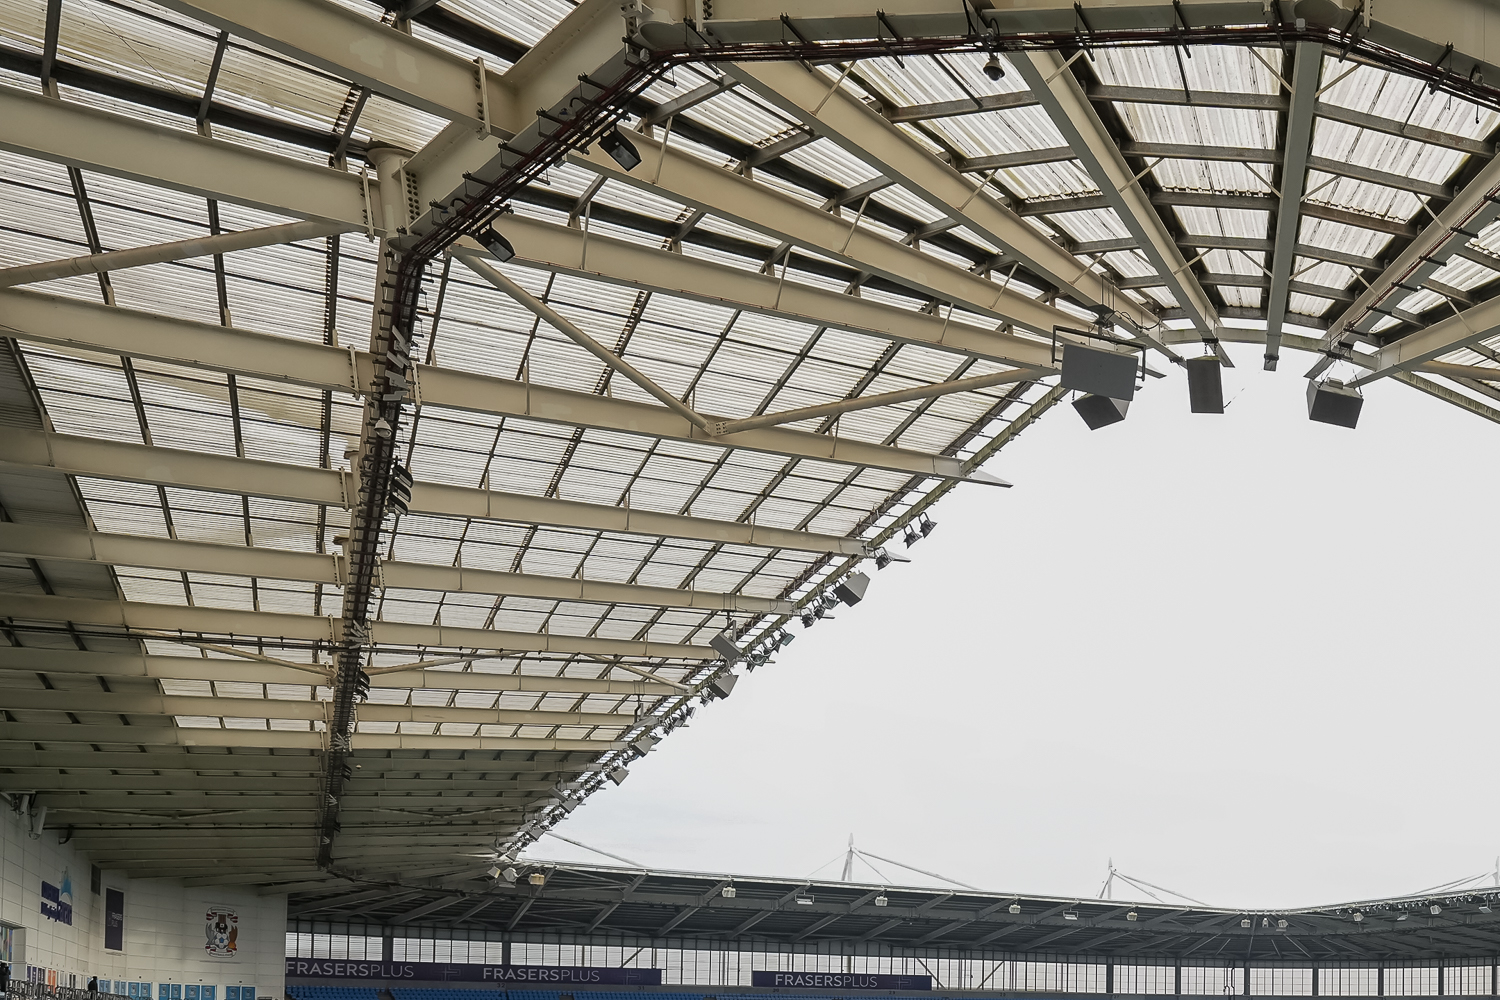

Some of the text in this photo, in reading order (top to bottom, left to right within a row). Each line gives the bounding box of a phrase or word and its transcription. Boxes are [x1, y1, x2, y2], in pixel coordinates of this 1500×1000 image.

[285, 961, 414, 978] FRASERSPLUS
[482, 967, 600, 982] FRASERSPLUS
[775, 974, 877, 988] FRASERSPLUS
